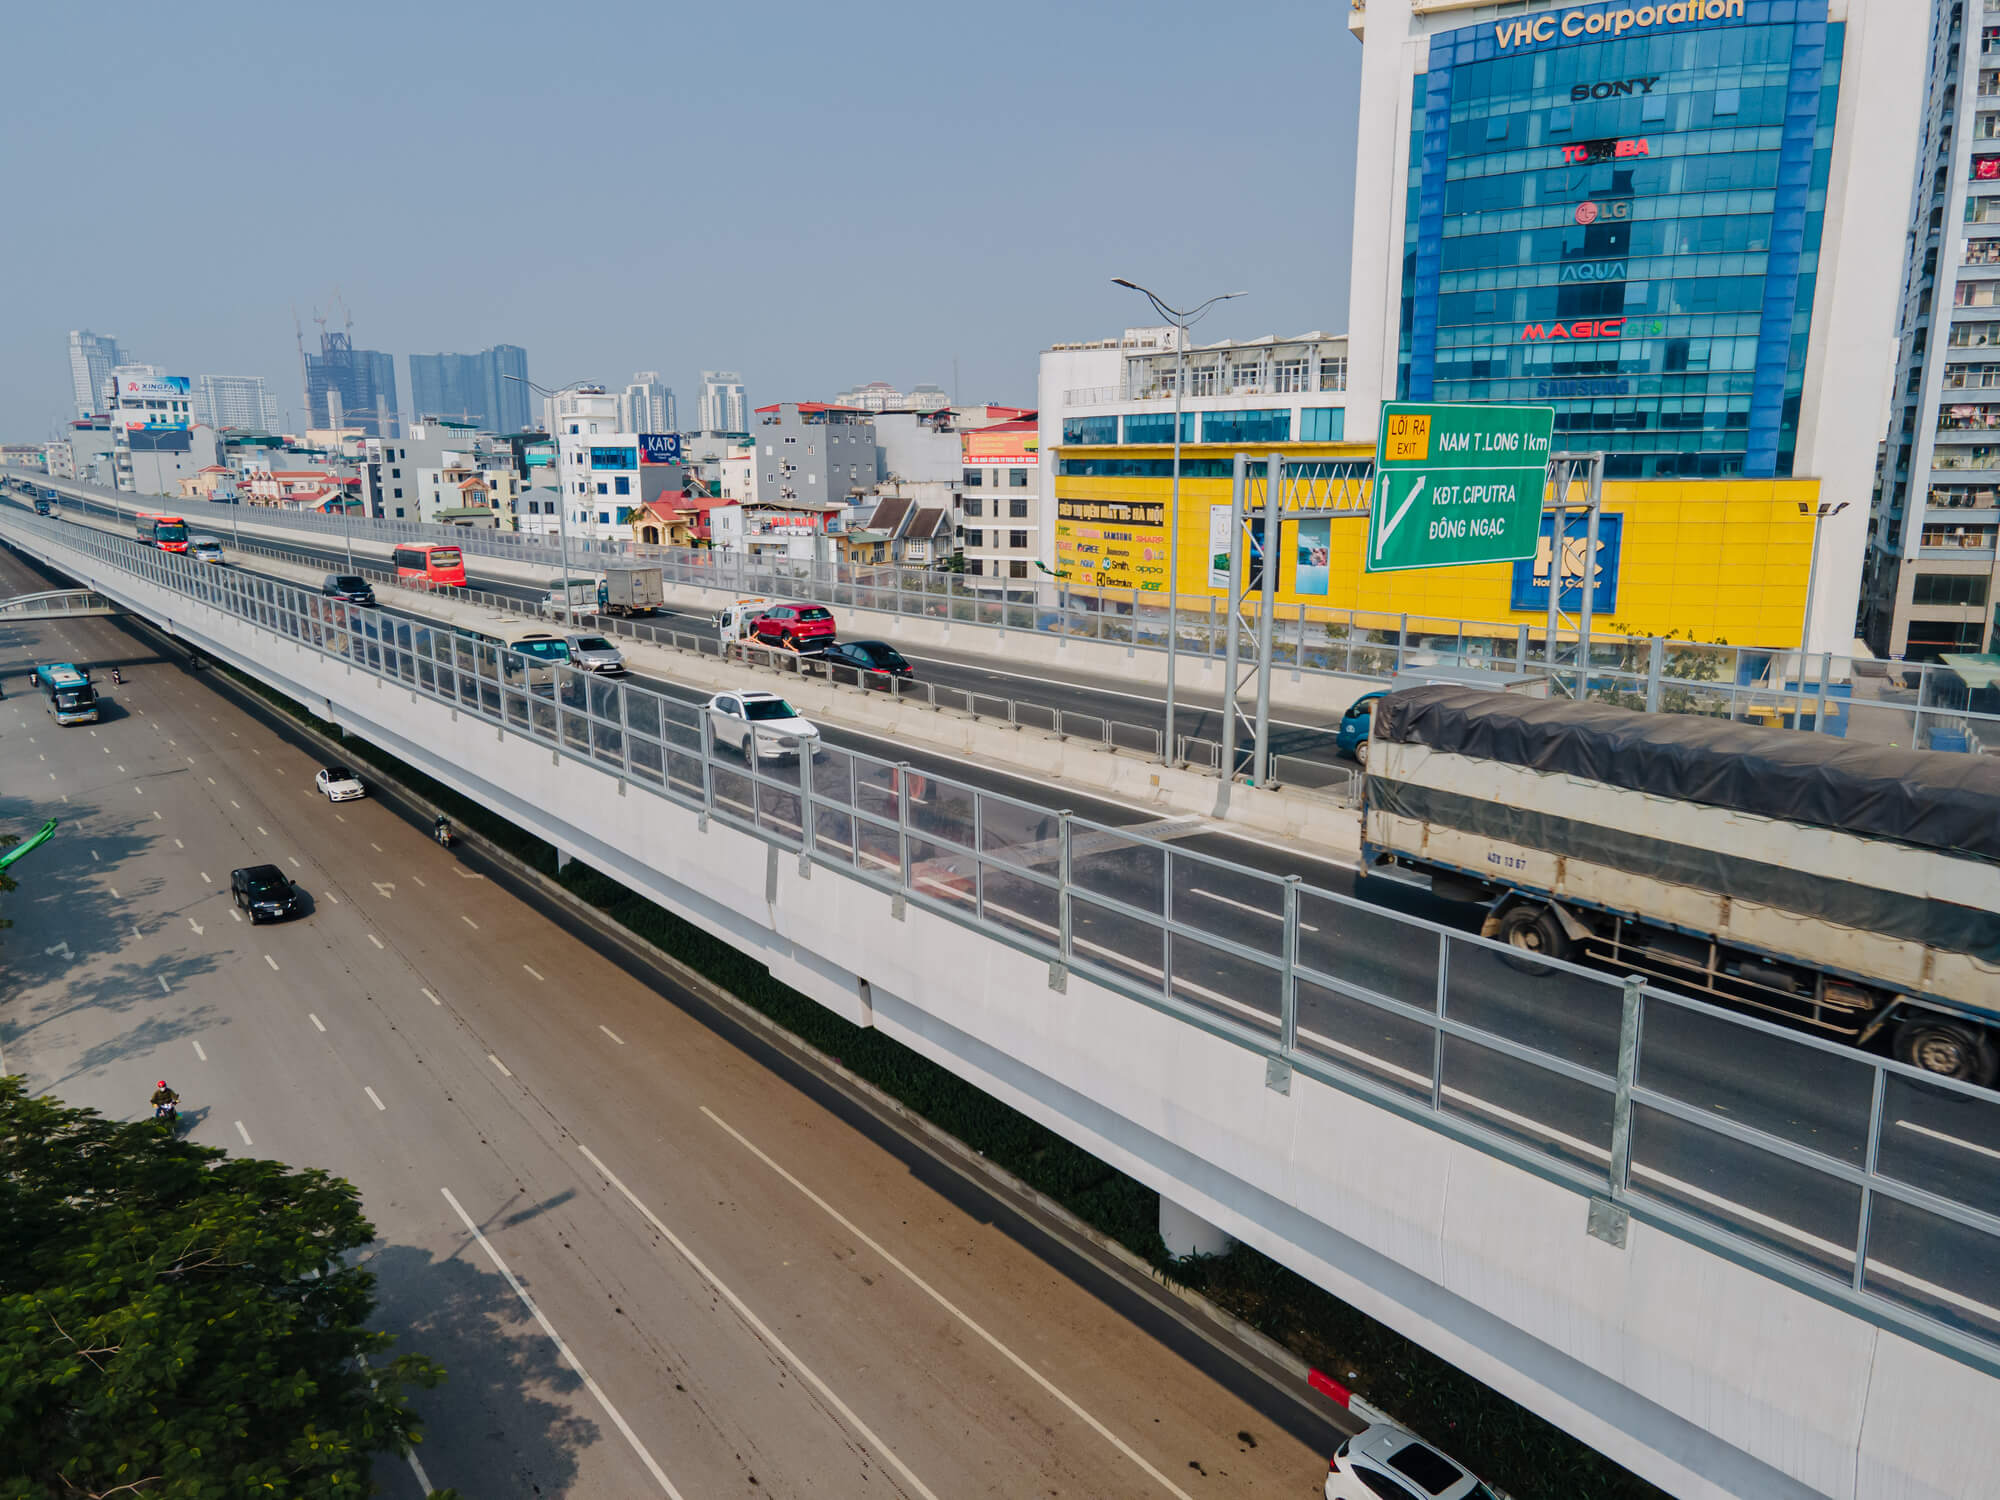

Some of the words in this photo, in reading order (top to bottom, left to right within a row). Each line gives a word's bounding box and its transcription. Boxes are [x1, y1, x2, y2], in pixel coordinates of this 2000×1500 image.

[1495, 17, 1555, 49] VHC
[1561, 0, 1744, 38] Corporation
[1570, 76, 1660, 101] SONY
[1561, 138, 1649, 162] TOIBA
[1601, 202, 1628, 219] LG
[1561, 262, 1626, 281] AQUA
[1521, 317, 1627, 340] MAGIC
[1537, 379, 1630, 397] SAMSUNG
[1413, 419, 1426, 435] RA
[648, 437, 676, 451] KATO
[1397, 442, 1417, 455] EXIT
[1439, 433, 1470, 451] NAM
[1474, 433, 1519, 451] T.LONG
[1523, 434, 1548, 451] 1km
[1432, 485, 1516, 505] KĐT.CIPUTRA
[1103, 531, 1133, 541] SAMSUNG
[1429, 517, 1466, 539] ĐÔNG
[1469, 517, 1506, 540] NGẠC
[1135, 535, 1164, 543] SHARP
[1106, 577, 1133, 588] Electrolux
[1141, 580, 1163, 591] acer
